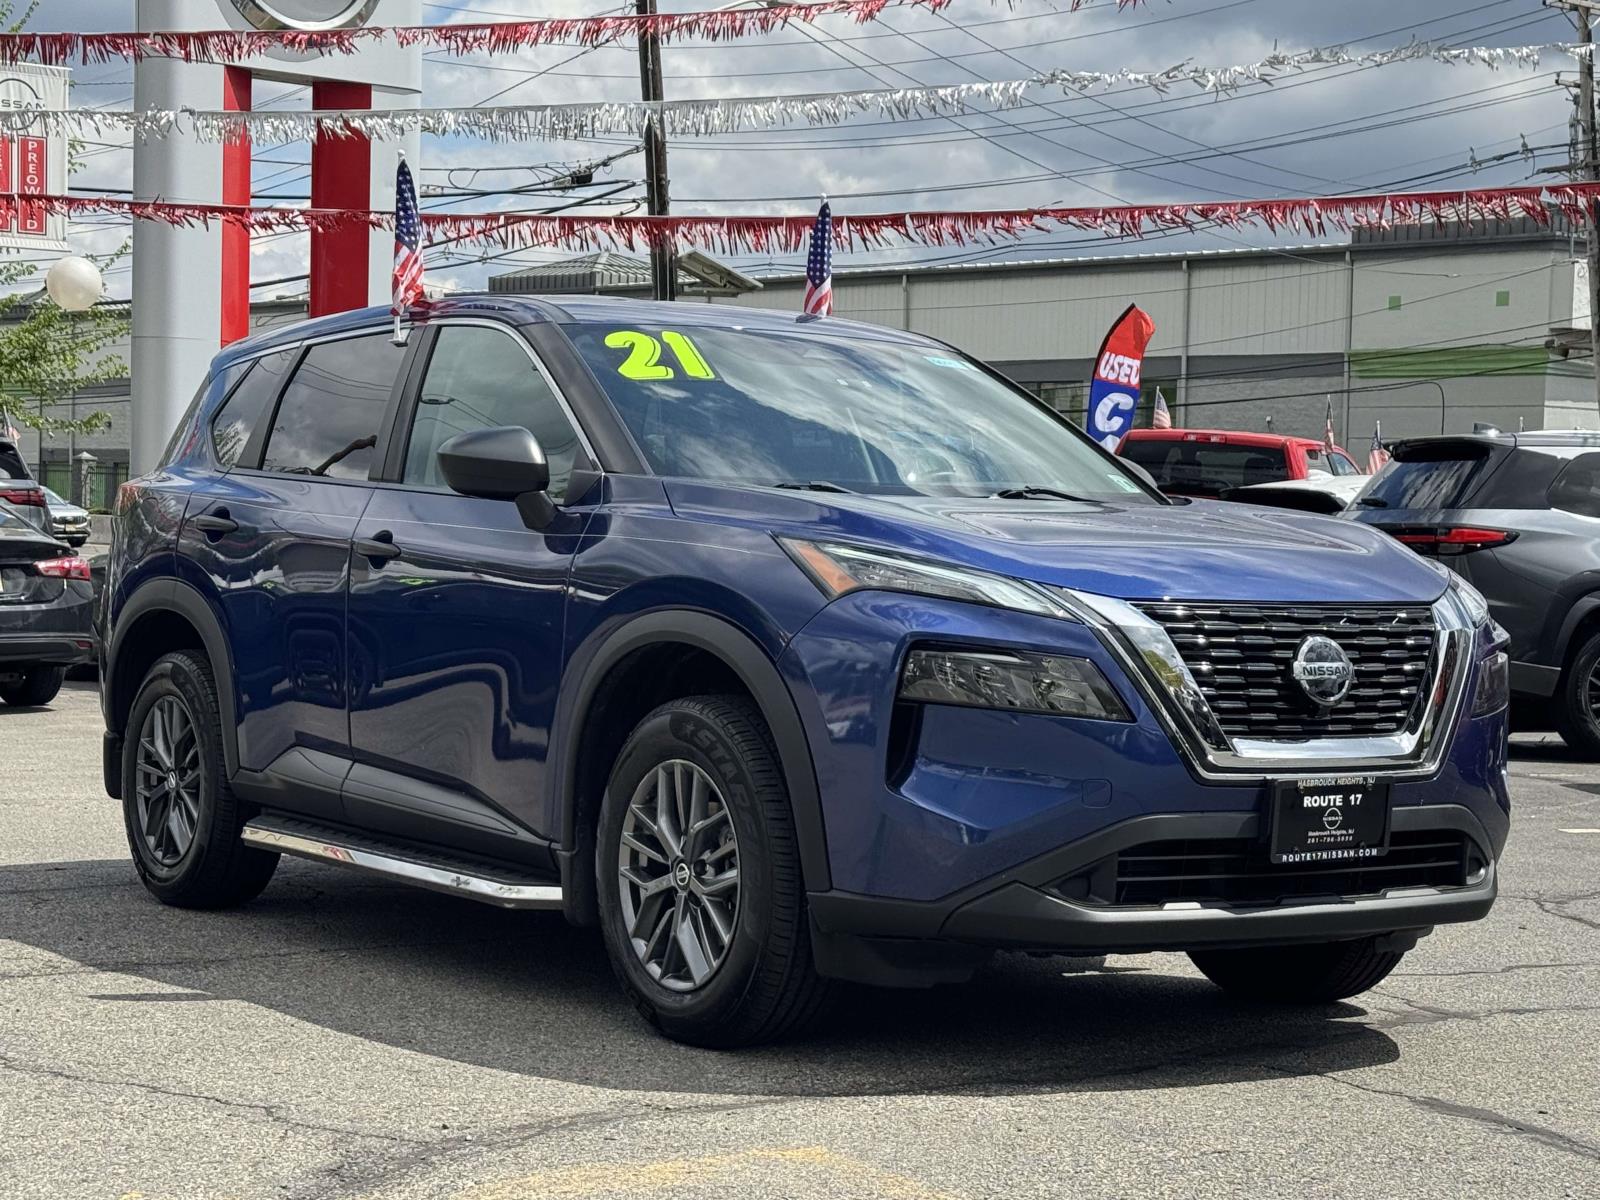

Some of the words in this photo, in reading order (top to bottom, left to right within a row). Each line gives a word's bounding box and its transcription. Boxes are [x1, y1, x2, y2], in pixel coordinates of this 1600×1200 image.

[0, 99, 46, 110] SSAN
[24, 141, 40, 230] PREOWD
[604, 330, 716, 380] 21
[1100, 352, 1141, 385] USED
[1302, 665, 1351, 676] NISSAN
[1298, 778, 1336, 788] HASBROUCK
[1303, 794, 1343, 807] ROUTE
[1349, 793, 1363, 806] 17
[1282, 848, 1378, 863] ROUTE17NISSAN.COM
